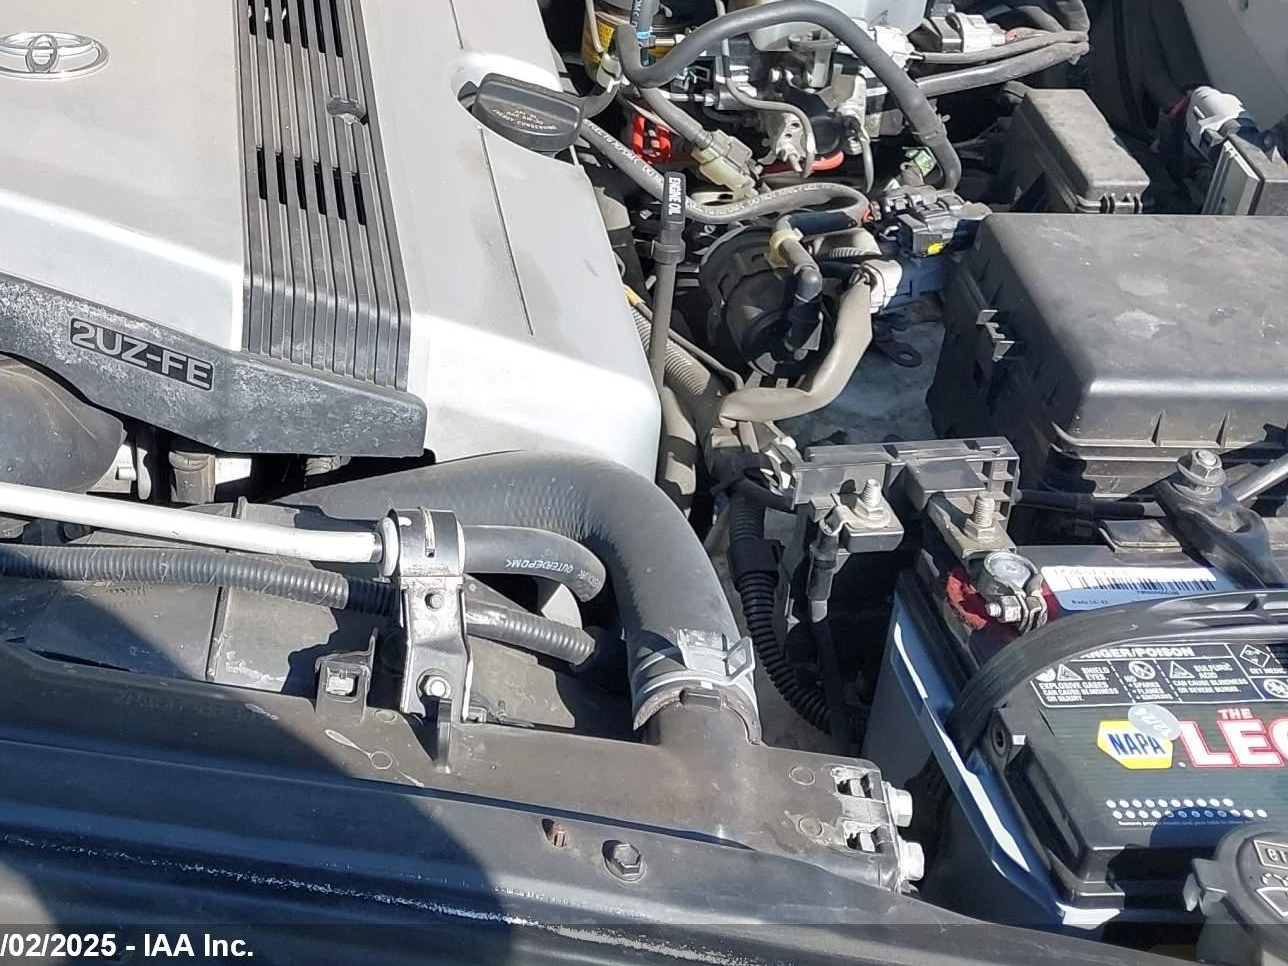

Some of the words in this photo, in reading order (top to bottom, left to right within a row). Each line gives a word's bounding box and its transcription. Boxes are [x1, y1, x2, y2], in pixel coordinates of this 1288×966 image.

[668, 176, 681, 202] ENGINE
[668, 202, 680, 216] OIL
[72, 320, 212, 390] 2UZ-FE
[1080, 646, 1196, 659] NGER/POISON
[1218, 708, 1254, 720] THE
[1107, 732, 1167, 756] NAPA
